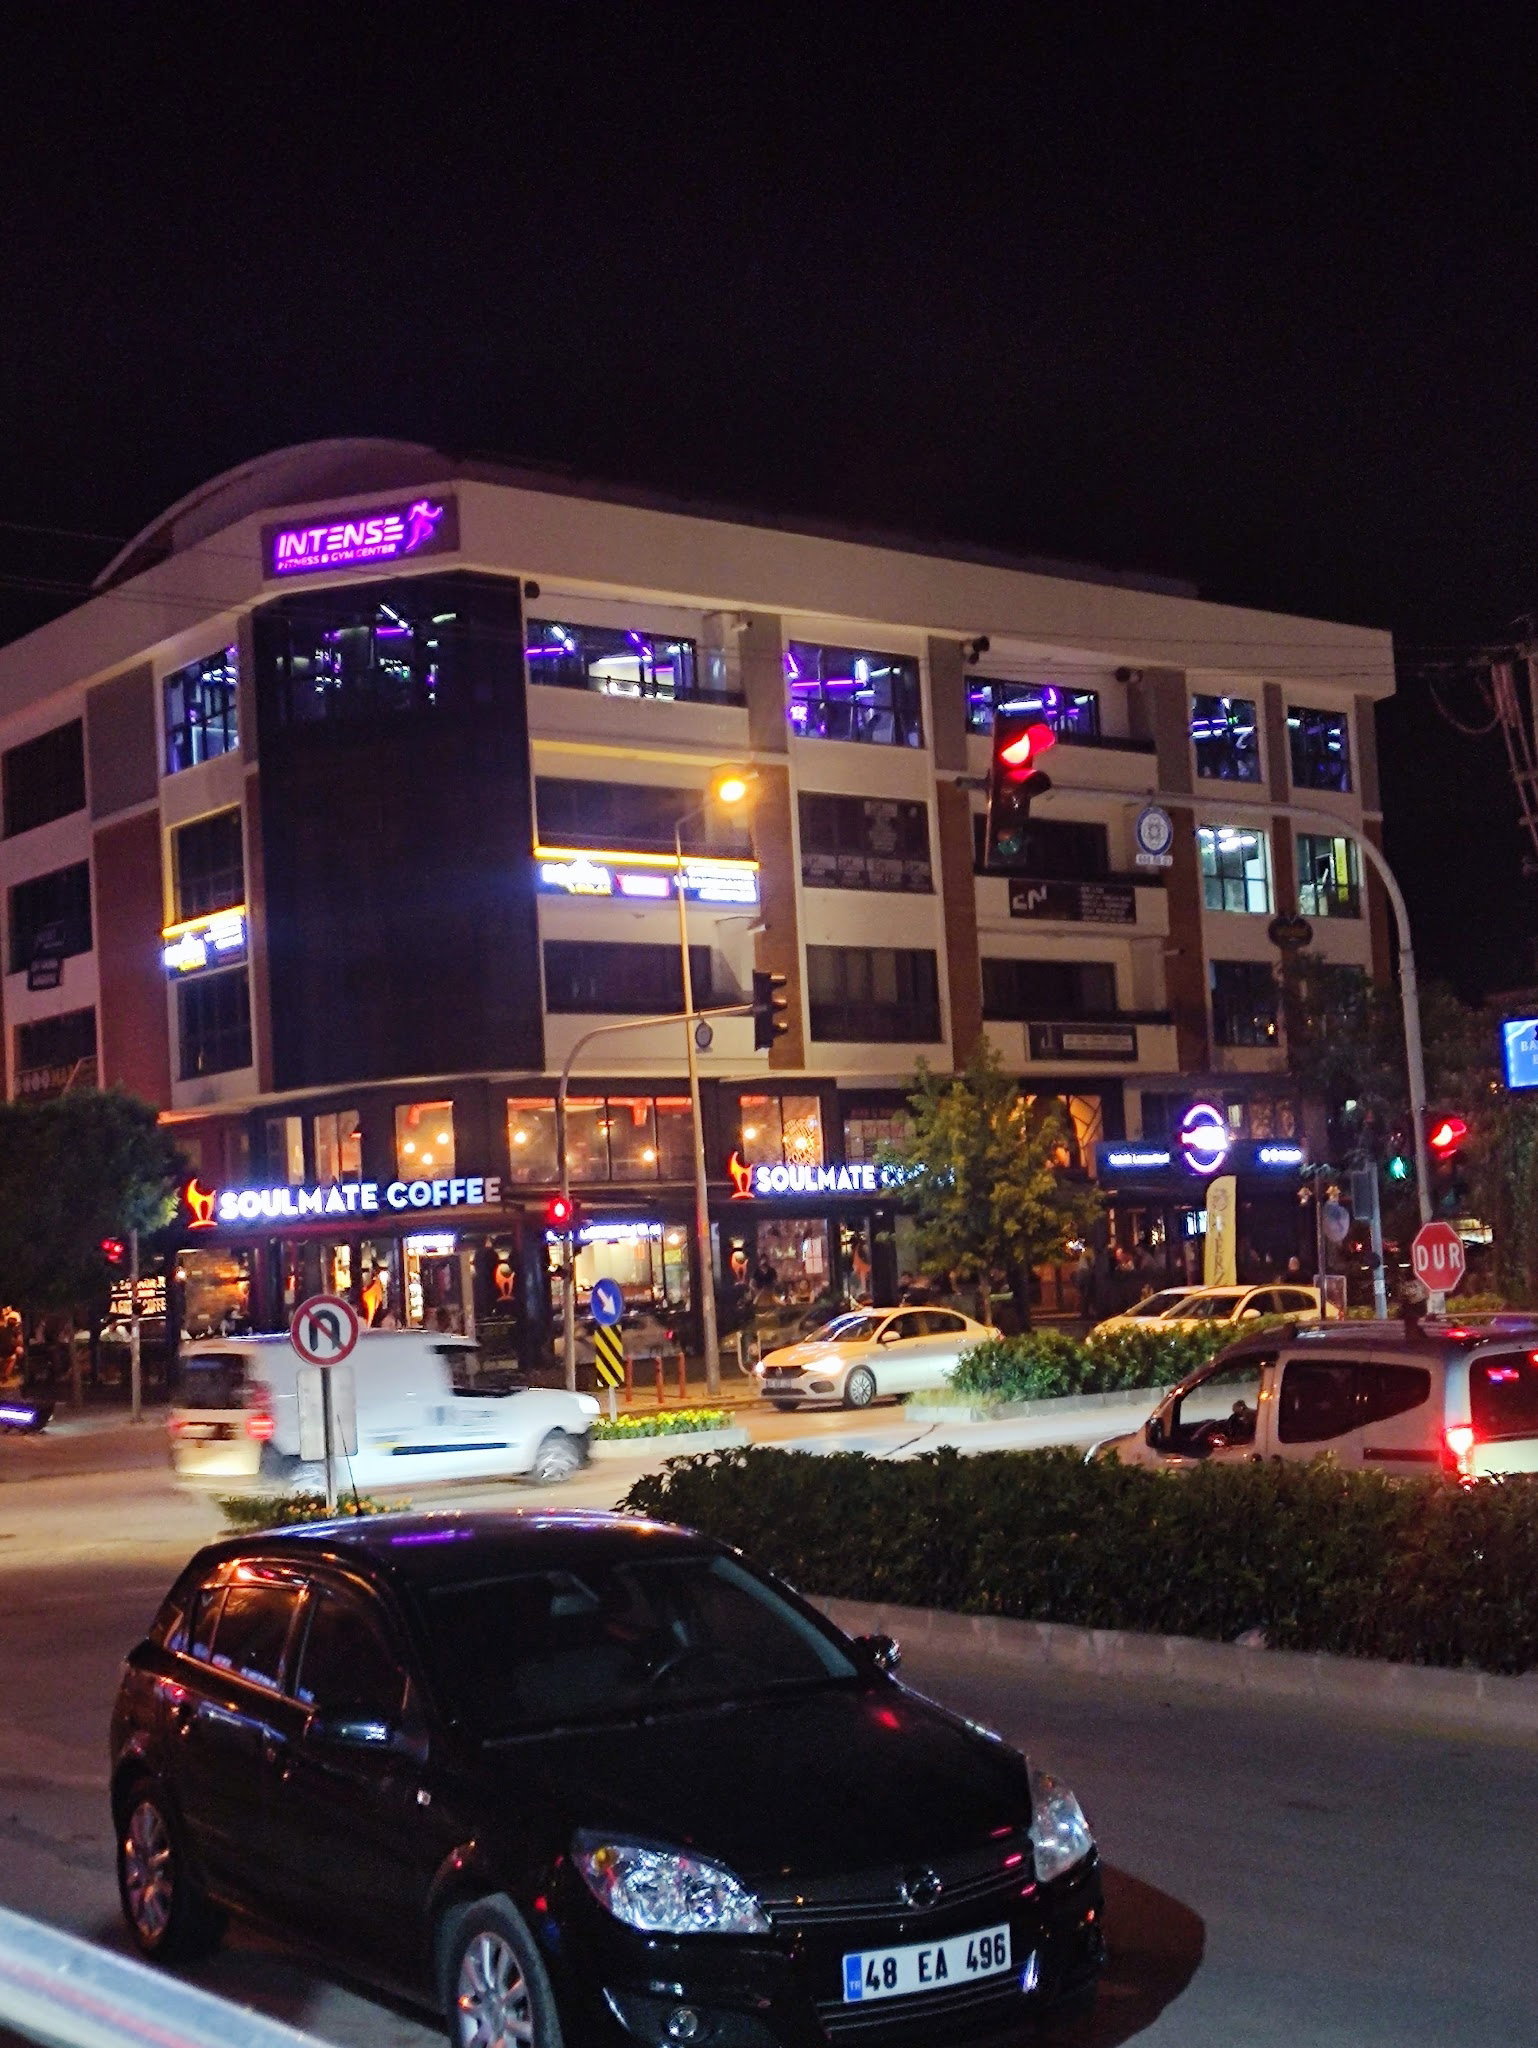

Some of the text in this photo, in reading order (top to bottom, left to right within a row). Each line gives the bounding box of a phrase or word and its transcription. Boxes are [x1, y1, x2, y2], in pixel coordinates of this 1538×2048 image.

[278, 516, 404, 558] INTENSE
[277, 555, 320, 570] FITNESS
[331, 550, 354, 562] GYM
[355, 543, 396, 557] CENTER
[756, 1164, 877, 1193] SOULMATE
[219, 1177, 501, 1220] SOULMATE COFFEE
[1416, 1242, 1460, 1271] DUR
[865, 1933, 1006, 1991] 48 EA 496
